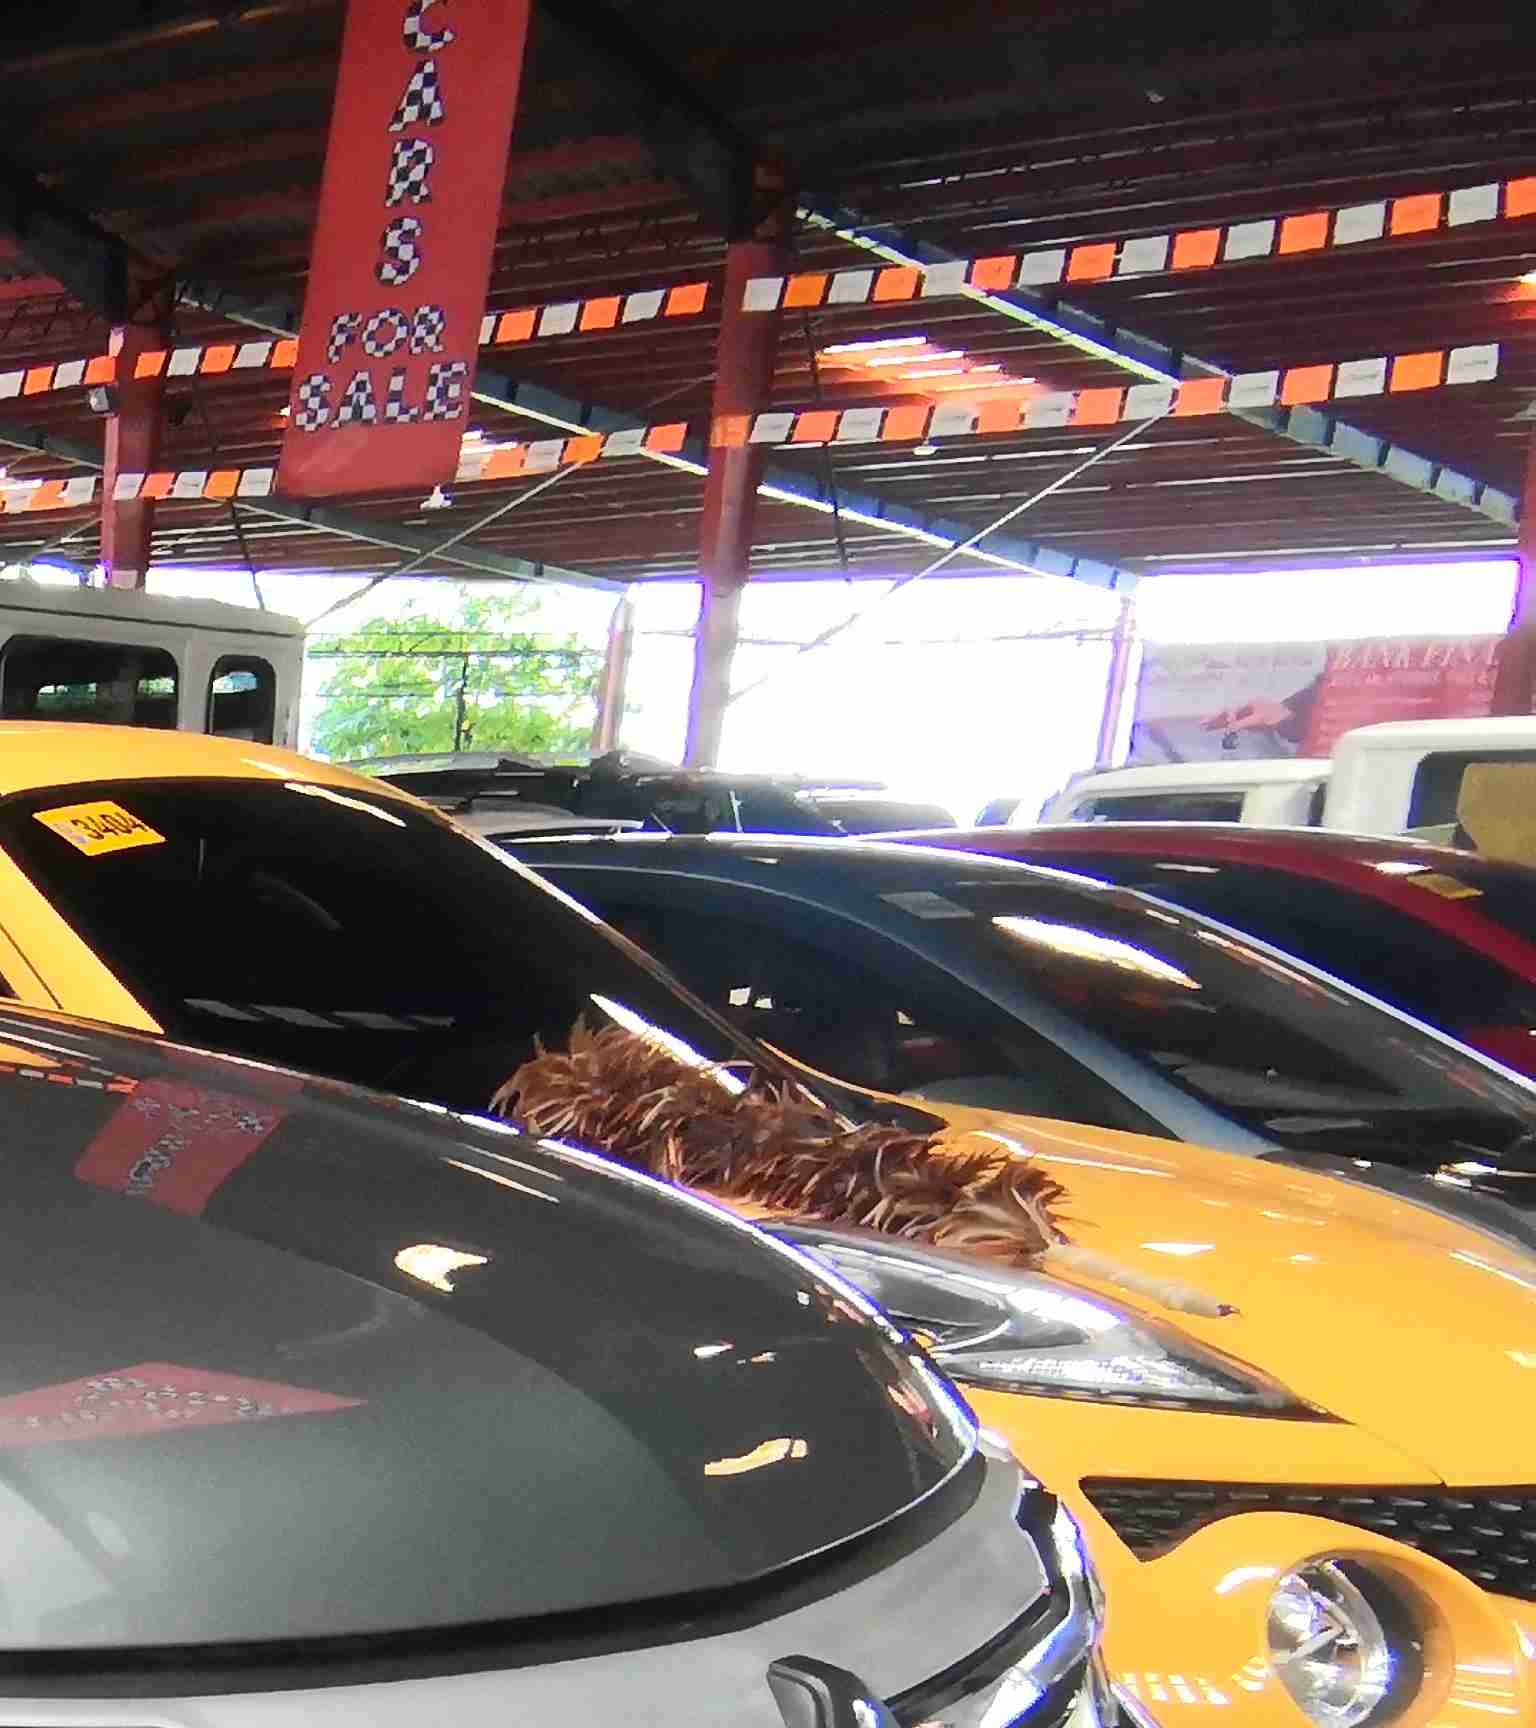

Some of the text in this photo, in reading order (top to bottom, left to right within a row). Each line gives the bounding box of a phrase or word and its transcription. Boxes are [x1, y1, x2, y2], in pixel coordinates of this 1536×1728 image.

[375, 0, 455, 287] CARS
[327, 304, 449, 365] FOR
[294, 360, 469, 433] SALE
